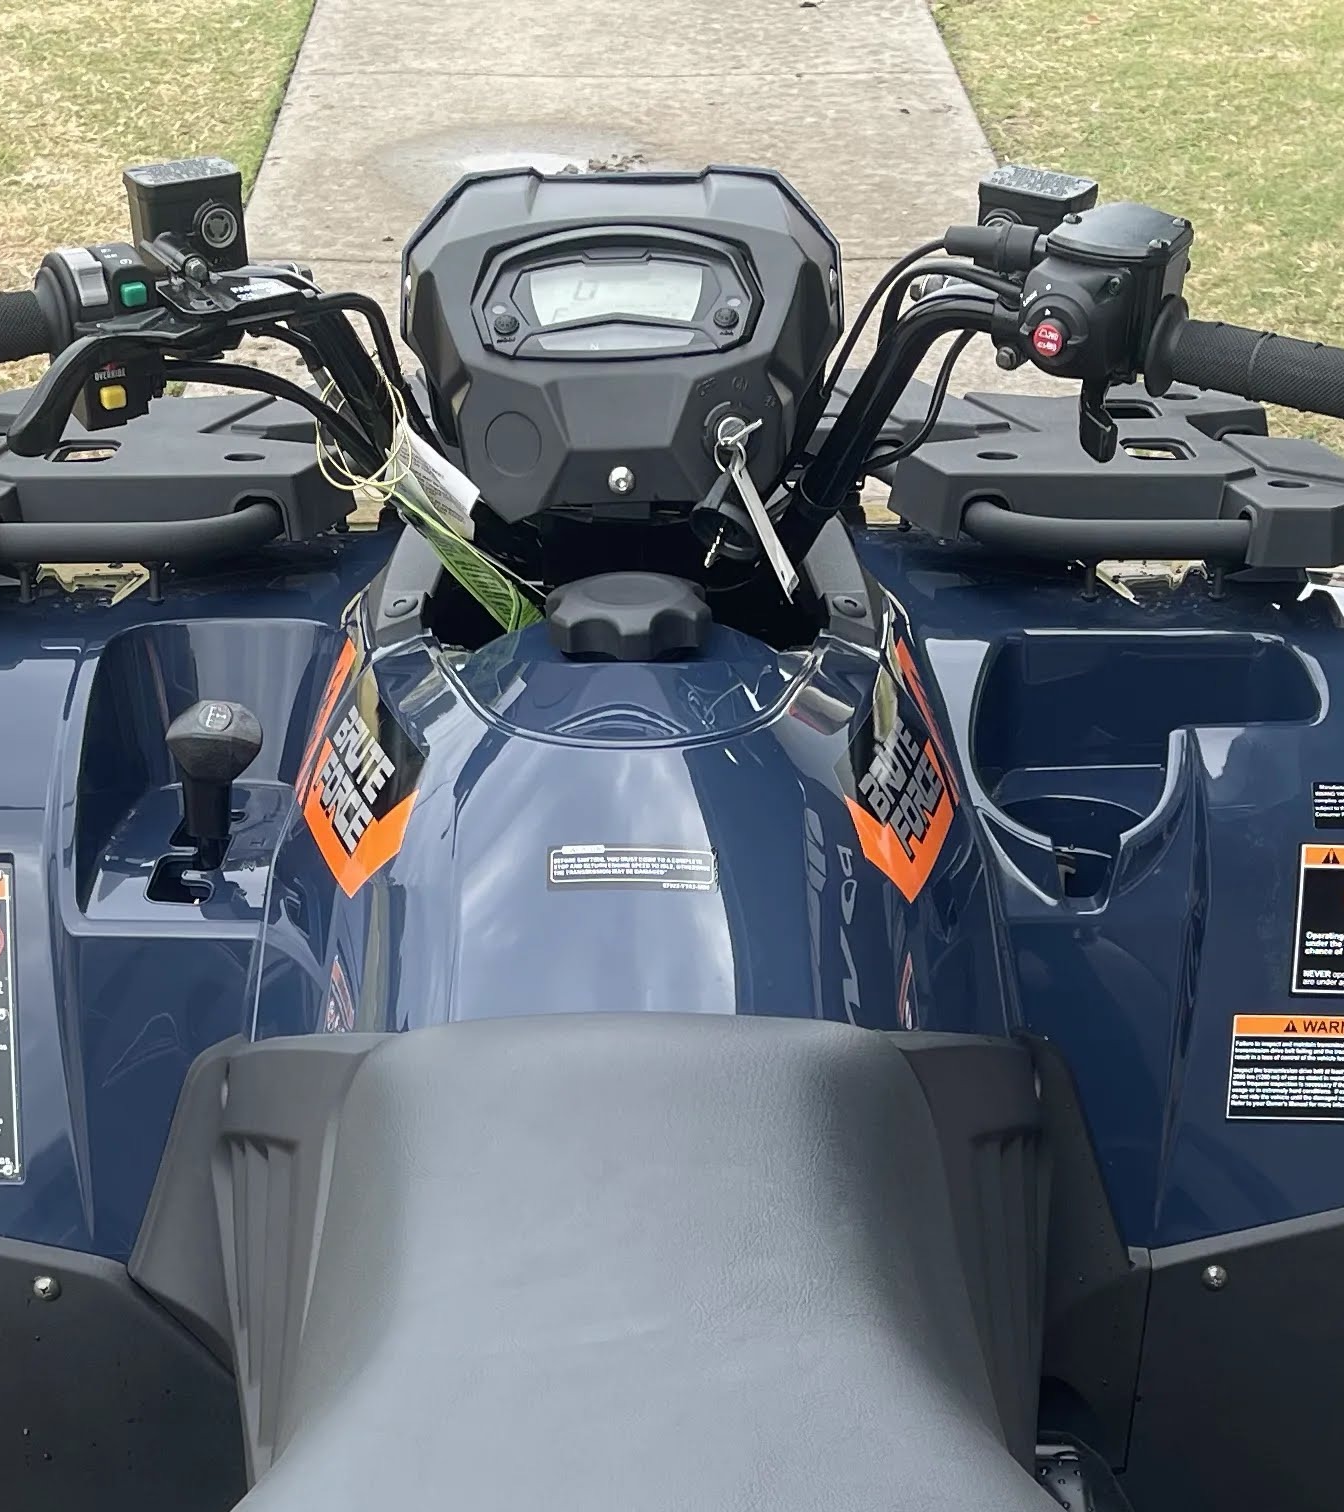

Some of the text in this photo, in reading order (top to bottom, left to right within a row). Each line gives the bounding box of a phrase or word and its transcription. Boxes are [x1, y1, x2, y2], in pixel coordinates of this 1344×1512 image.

[314, 749, 374, 854] FORCE
[333, 705, 396, 805] BRUTE
[858, 715, 921, 827] BRUTE
[889, 751, 945, 862] FORCE
[1303, 970, 1331, 978] NEVER
[1306, 931, 1344, 941] Operating
